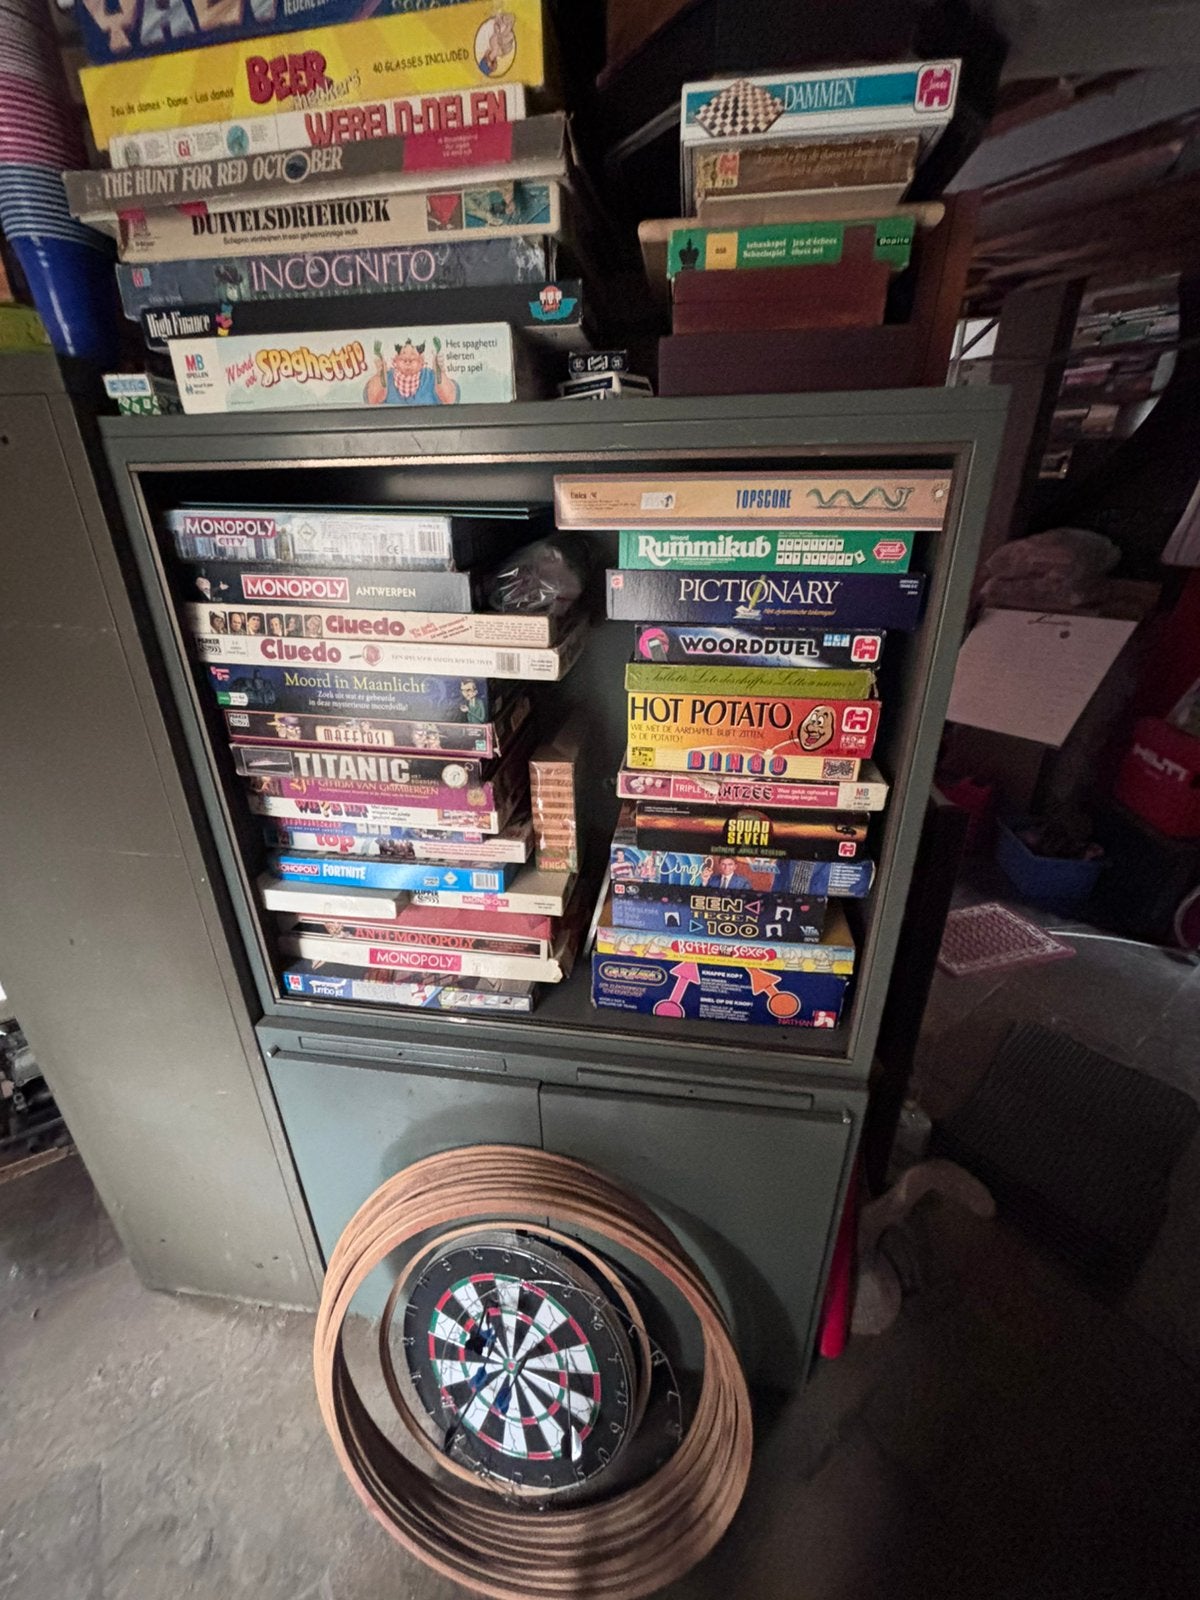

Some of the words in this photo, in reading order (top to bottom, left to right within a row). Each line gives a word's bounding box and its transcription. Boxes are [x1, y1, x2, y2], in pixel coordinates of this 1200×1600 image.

[385, 57, 423, 72] GLASSES
[425, 48, 469, 65] INCLUDED
[246, 50, 333, 104] BEER
[784, 80, 857, 111] DAMMEN
[103, 172, 133, 198] THE
[135, 168, 178, 195] HUNT
[182, 164, 213, 191] FOR
[217, 158, 247, 186] RED
[253, 146, 343, 183] OCTOBER
[192, 198, 390, 236] DUIVELSDRIEHOEK
[251, 249, 435, 291] INCOGNITO
[146, 312, 171, 341] High
[172, 312, 211, 336] Finance
[445, 339, 461, 349] Het
[462, 338, 498, 351] spaghetti
[185, 354, 205, 372] MB
[446, 351, 475, 361] slierten
[447, 362, 466, 375] slurp
[467, 362, 484, 374] spel
[736, 488, 792, 509] TOPSCORE
[185, 518, 275, 536] MONOPOLY
[218, 535, 245, 546] CITY
[638, 534, 772, 567] Rummikub
[247, 577, 345, 598] MONOPOLY
[356, 586, 416, 598] ANTWERPEN
[679, 577, 841, 605] PICTIONARY
[325, 615, 405, 636] Cluedo
[261, 638, 342, 663] Cluedo
[680, 636, 818, 657] WOORDDUEL
[284, 672, 330, 688] Moord
[335, 675, 349, 689] in
[353, 676, 426, 693] Maanlicht
[631, 696, 683, 723] HOT
[690, 699, 792, 730] POTATO
[631, 723, 645, 732] WIE
[647, 724, 661, 733] MET
[663, 725, 673, 733] DE
[675, 726, 713, 737] AARDAPPEL
[639, 733, 648, 741] DE
[650, 734, 684, 743] POTATO!
[293, 751, 410, 783] TITANIC
[687, 750, 788, 776] BINGO
[356, 781, 376, 791] VAN
[675, 783, 701, 795] TRIPLE
[856, 787, 869, 796] MB
[728, 819, 770, 834] SQUAD
[727, 833, 768, 846] SEVEN
[322, 864, 367, 880] FORTNITE
[462, 895, 508, 907] MONOPOLY
[690, 895, 743, 913] EEN
[692, 911, 759, 923] TEGEN
[354, 928, 476, 949] ANTI-MONOPOLY
[707, 921, 759, 938] 100
[677, 938, 719, 954] Battle
[731, 944, 770, 961] Sexes
[376, 951, 454, 968] MONOPOLY
[778, 1017, 813, 1027] NATHAN
